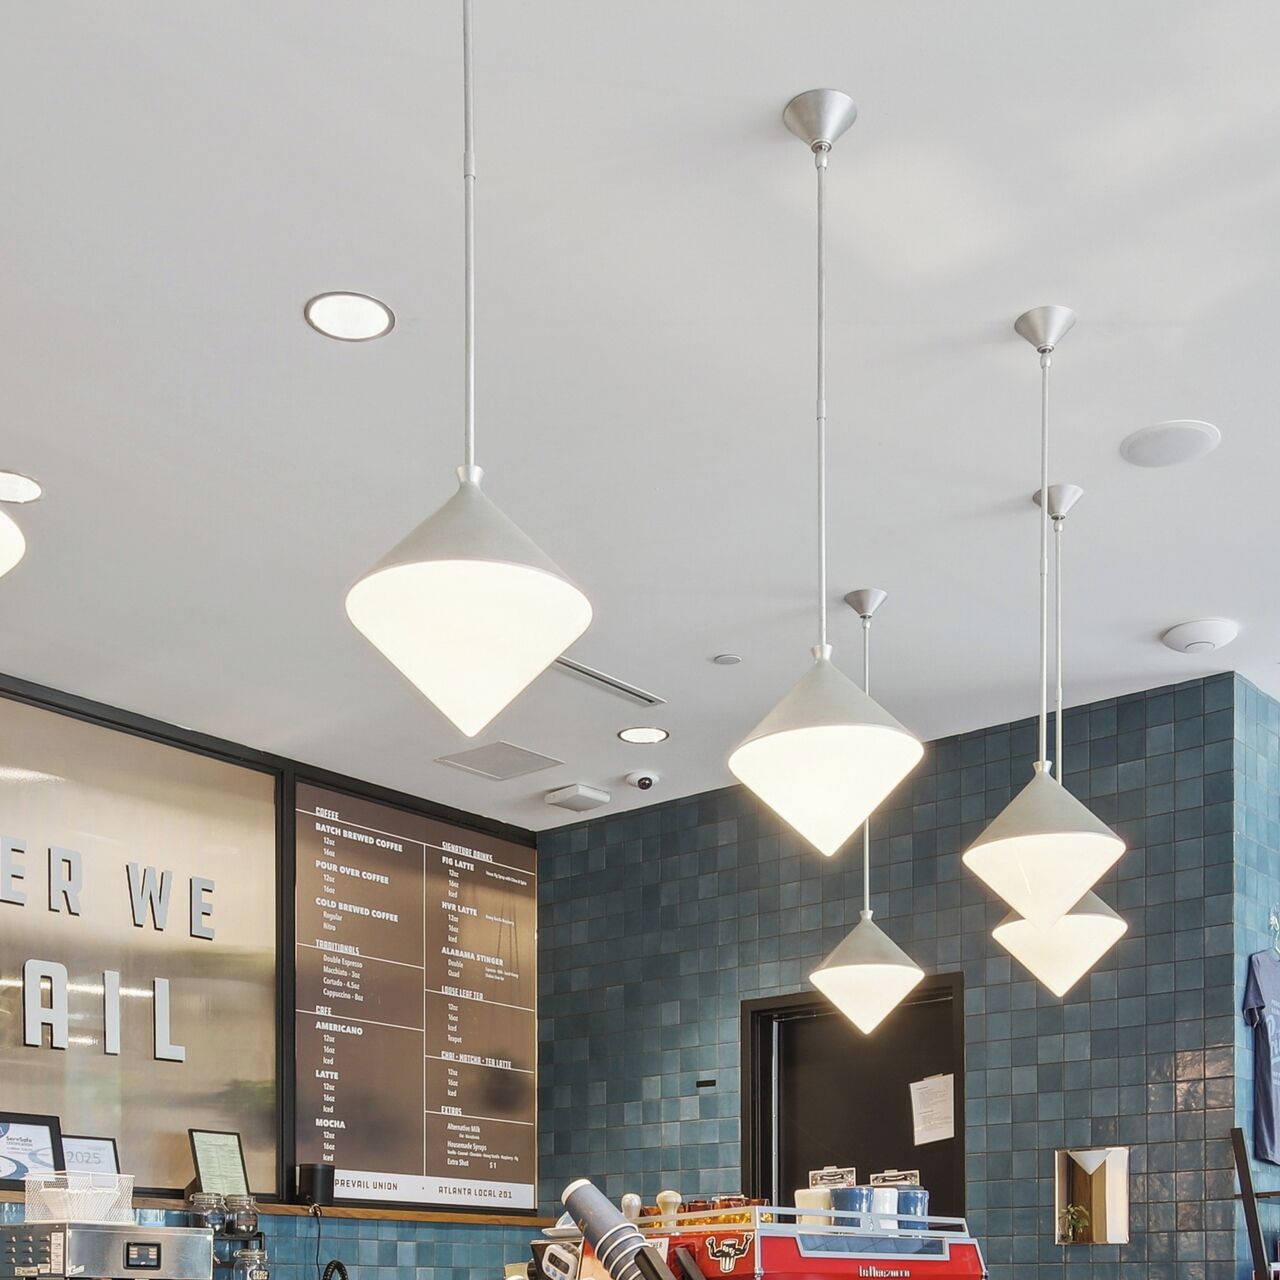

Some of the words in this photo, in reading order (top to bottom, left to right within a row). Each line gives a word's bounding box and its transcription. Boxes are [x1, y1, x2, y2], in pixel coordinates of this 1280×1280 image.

[315, 807, 340, 821] COFFEE
[315, 823, 341, 836] BATCH
[343, 830, 374, 845] BREWED
[376, 839, 403, 852] COFFEE
[323, 837, 335, 846] 12oz
[323, 848, 335, 857] 16oz
[442, 842, 472, 858] SIGNATURE
[473, 848, 493, 862] DRINKS
[442, 856, 453, 866] FIG
[454, 860, 475, 872] LATTE
[315, 860, 338, 872] POUR
[340, 866, 360, 878] OVER
[362, 872, 389, 884] COFFEE
[323, 874, 335, 883] 12oz
[323, 885, 335, 894] 16oz
[126, 862, 216, 939] WE
[315, 897, 337, 909] COLD
[338, 902, 370, 916] BREWED
[372, 908, 399, 922] COFFEE
[442, 901, 457, 912] HVR
[458, 905, 478, 917] LATTE
[323, 911, 342, 922] Regular
[323, 923, 336, 932] Nitro
[323, 954, 341, 965] Double
[342, 958, 363, 969] Espresso
[442, 946, 475, 961] ALABAMA
[476, 954, 504, 967] STINGER
[448, 959, 464, 969] Double
[323, 966, 348, 977] Macchiato
[323, 977, 343, 987] Cortado
[323, 988, 351, 1000] Cappuccino
[442, 986, 459, 998] LOOSE
[315, 1005, 332, 1016] CAFE
[315, 1021, 363, 1035] AMERICANO
[323, 1034, 335, 1043] 12oz
[448, 1034, 462, 1044] Teapot
[323, 1046, 335, 1054] 16oz
[315, 1069, 339, 1080] LATTE
[323, 1083, 335, 1091] 12oz
[323, 1094, 335, 1102] 16oz
[441, 1105, 462, 1116] EXTRAS
[315, 1118, 346, 1129] MOCHA
[447, 1122, 471, 1133] Alternative
[471, 1125, 481, 1133] Milk
[323, 1131, 335, 1139] 12oz
[323, 1142, 335, 1150] 16oz
[447, 1141, 472, 1151] Housemade
[473, 1143, 487, 1153] Syrups
[67, 1150, 101, 1165] 2025
[447, 1158, 459, 1166] Extra
[459, 1159, 469, 1167] Shot
[334, 1178, 370, 1189] PREVAIL
[372, 1182, 398, 1191] UNION
[439, 1186, 472, 1196] ATLANTA
[474, 1188, 497, 1198] LOCAL
[499, 1190, 513, 1199] 201
